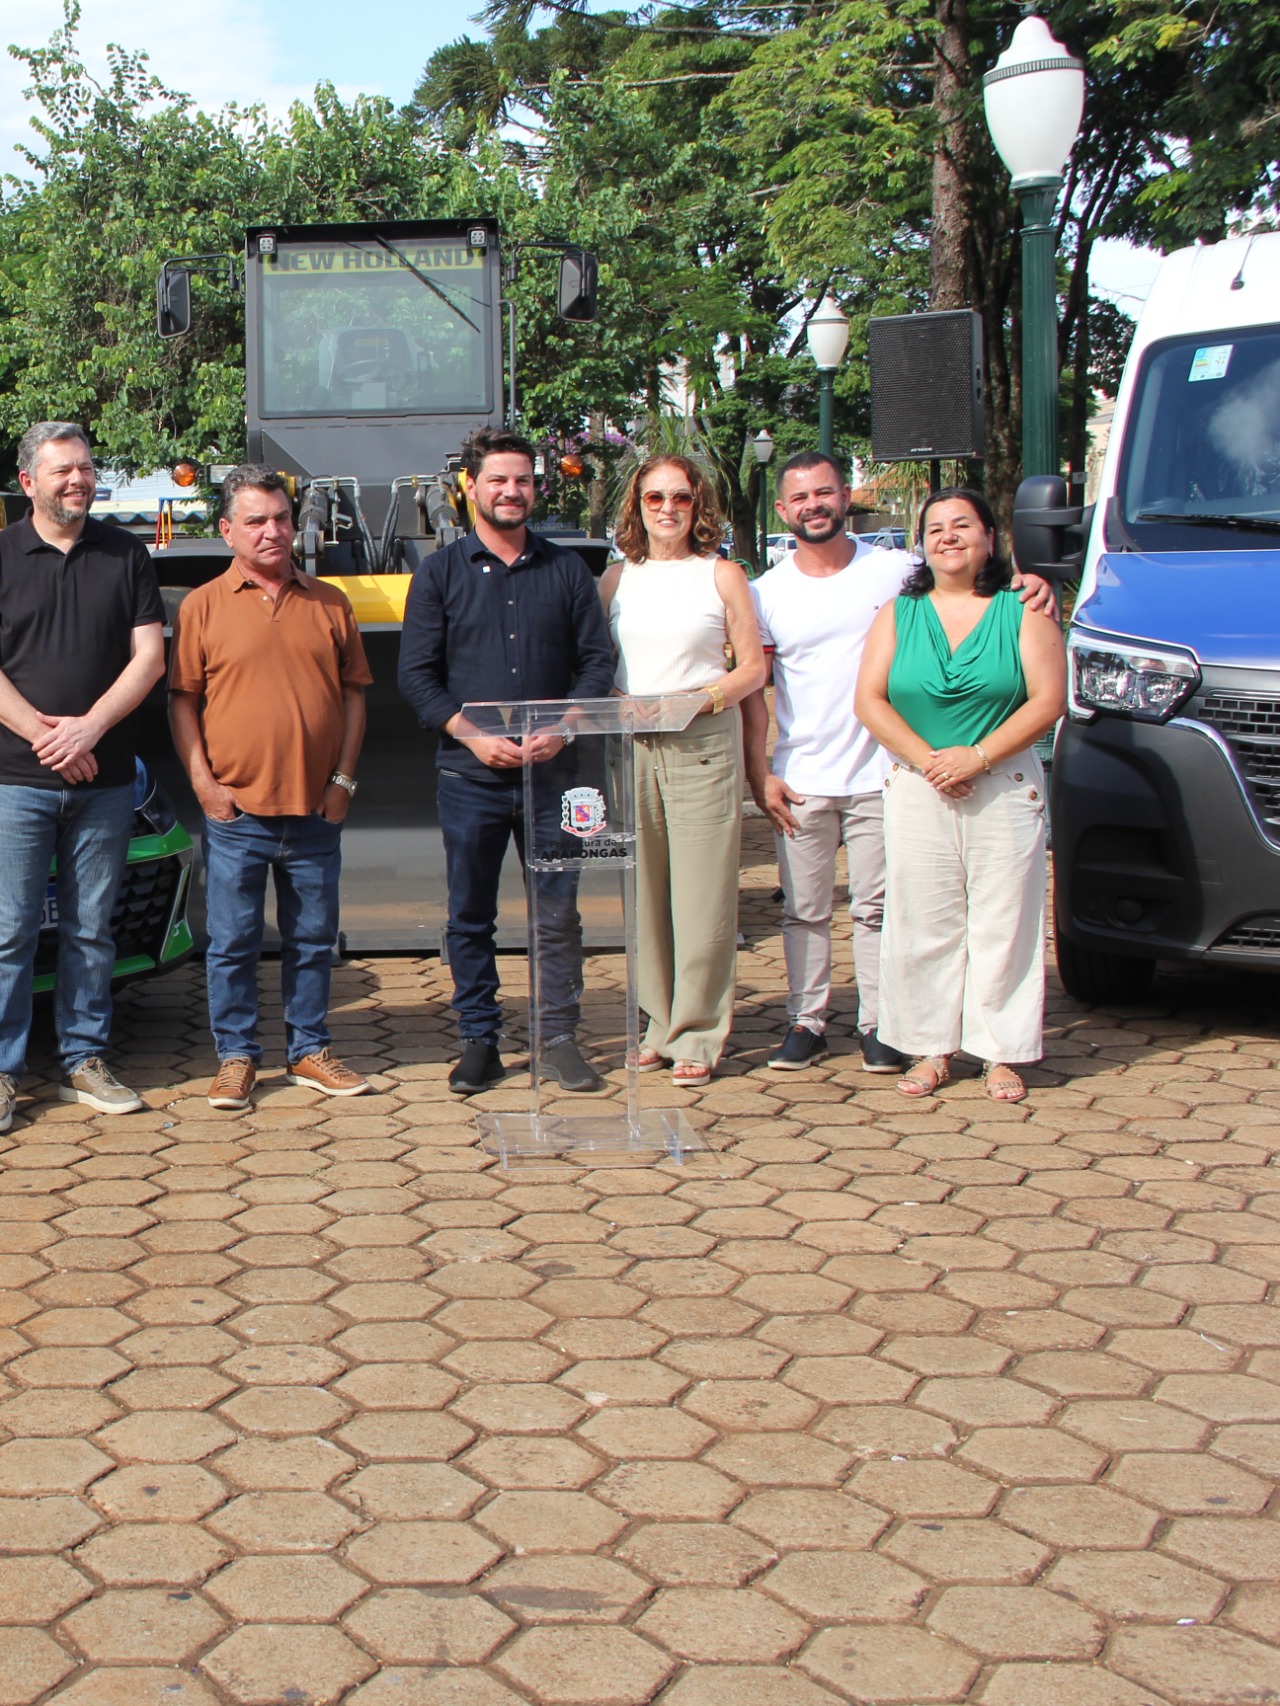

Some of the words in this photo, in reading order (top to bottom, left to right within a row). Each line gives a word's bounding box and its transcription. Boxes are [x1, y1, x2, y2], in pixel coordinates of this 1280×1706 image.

[271, 251, 335, 271] NEW
[604, 838, 617, 847] de
[541, 848, 627, 860] ARAPONGAS
